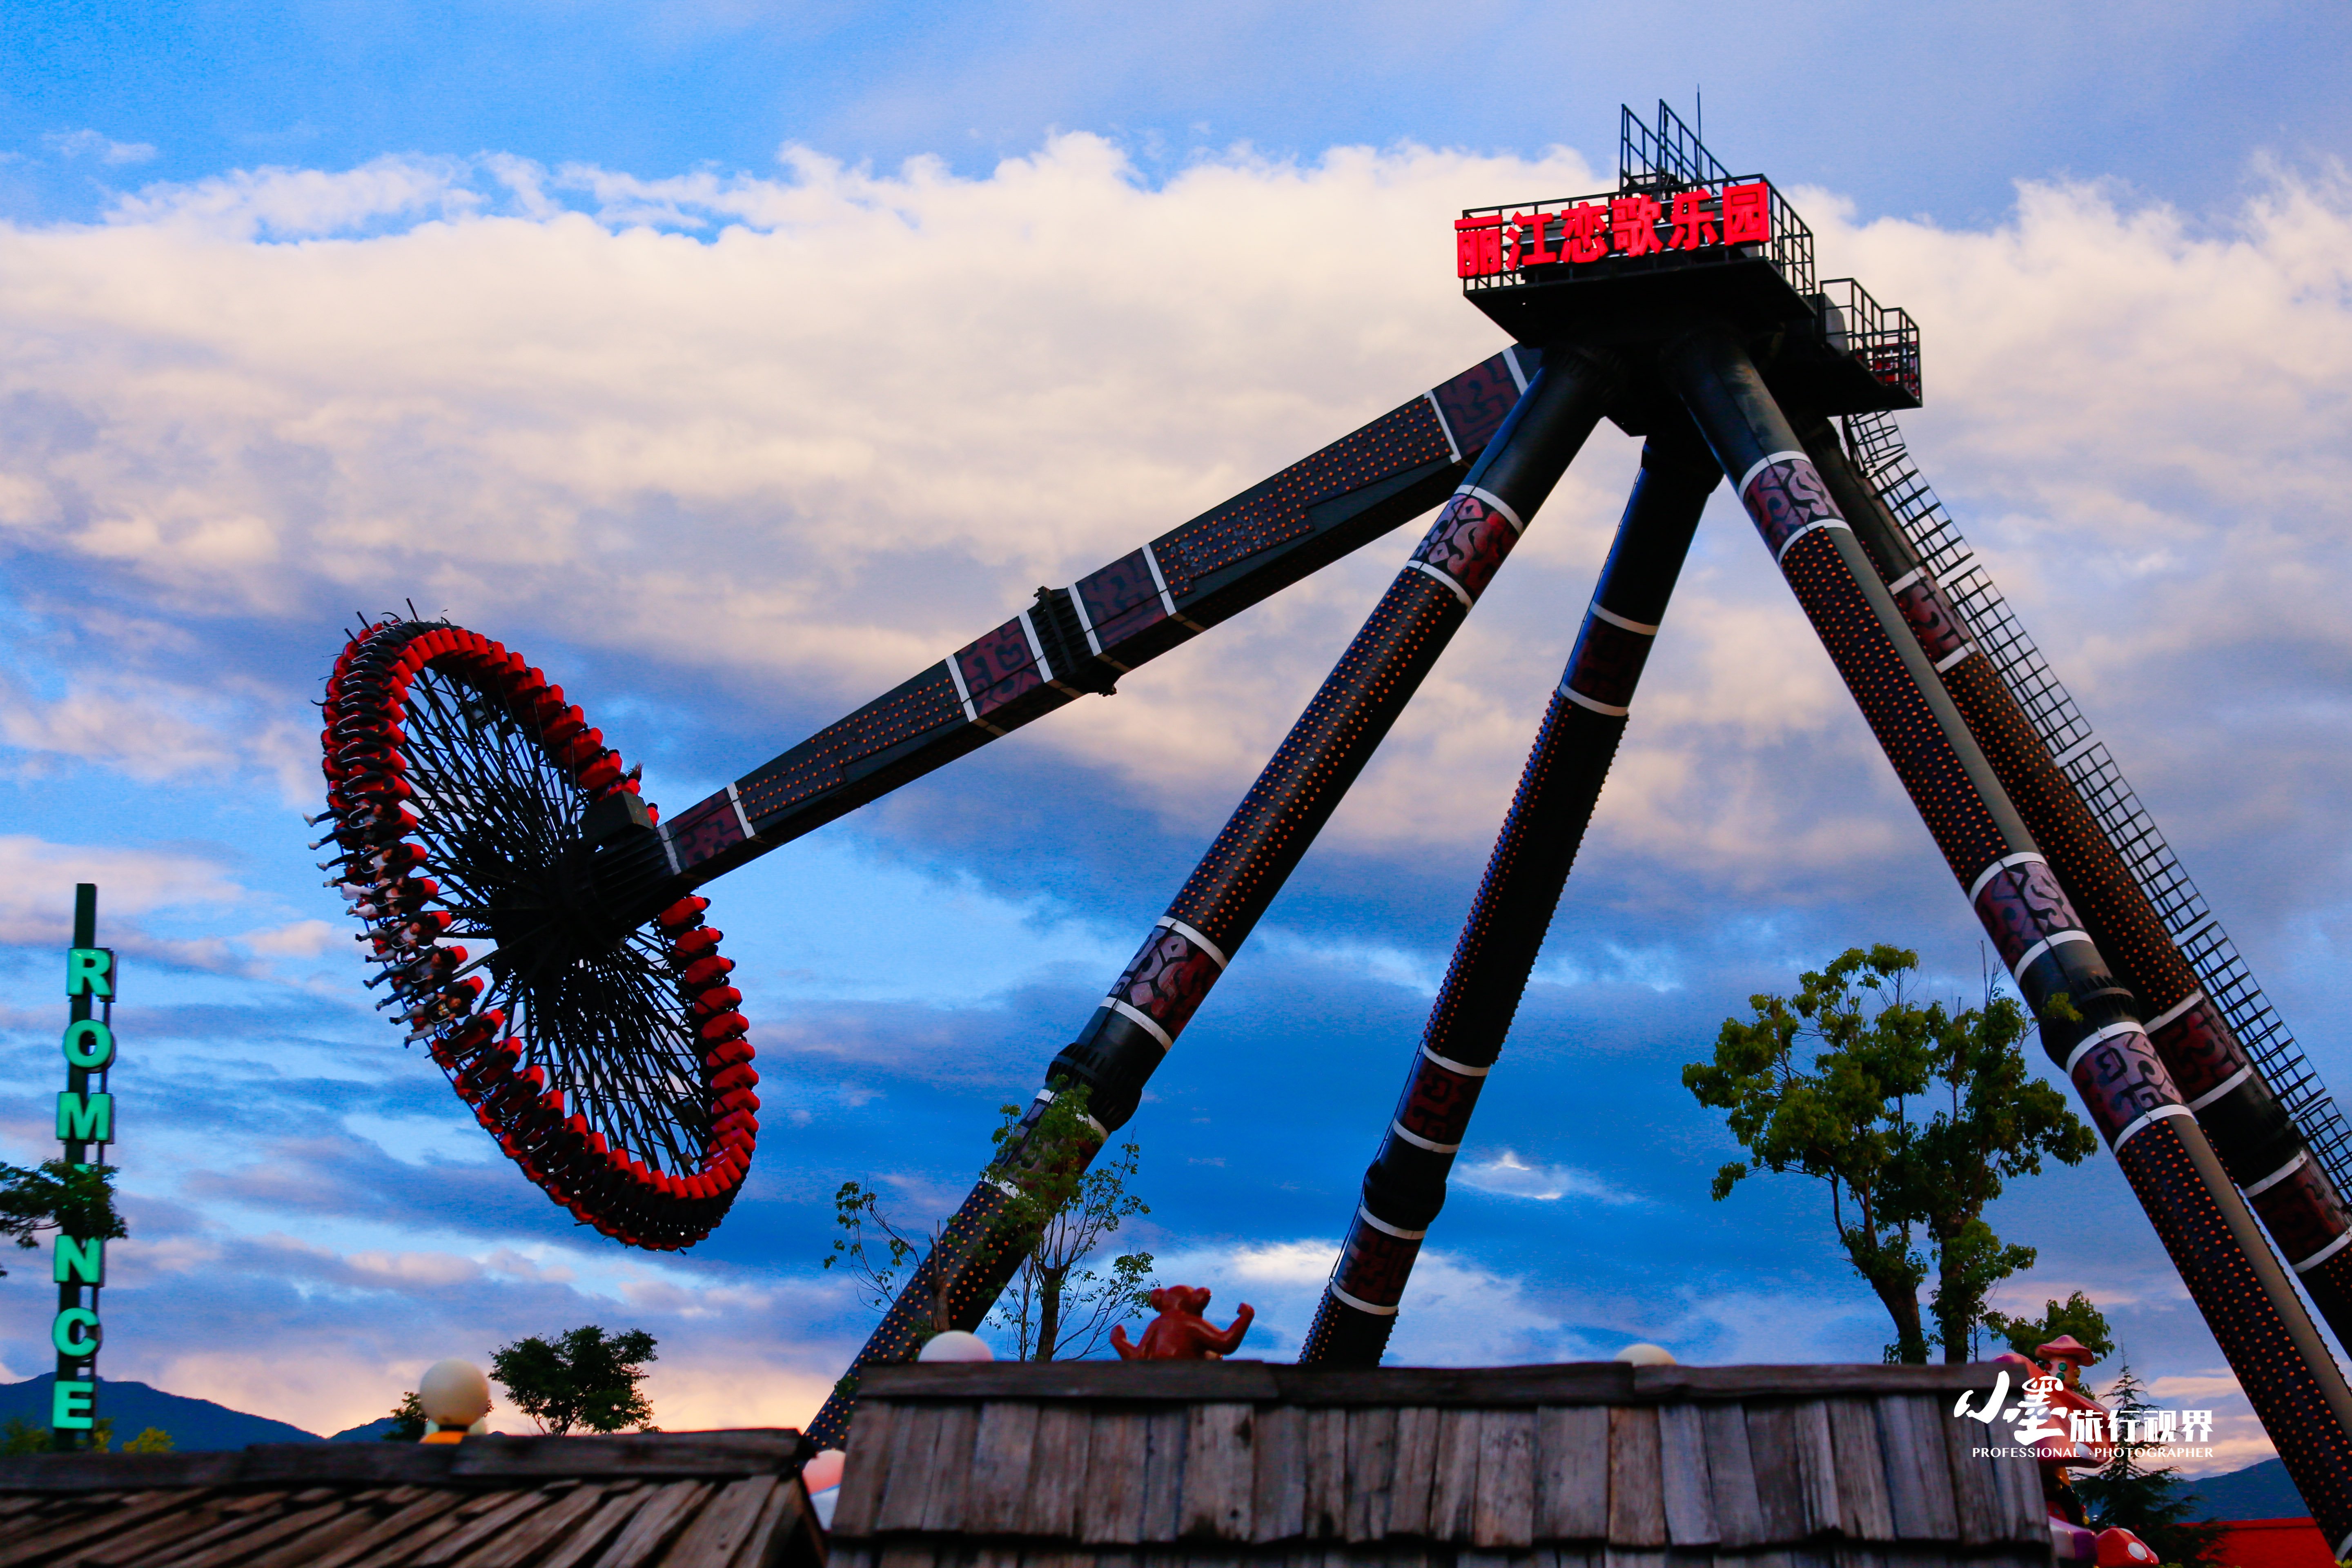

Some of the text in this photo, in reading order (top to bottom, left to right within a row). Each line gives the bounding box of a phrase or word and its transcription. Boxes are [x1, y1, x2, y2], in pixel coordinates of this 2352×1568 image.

[1454, 182, 1770, 278] 丽江恋歌乐园
[52, 948, 115, 1429] ROMNCE
